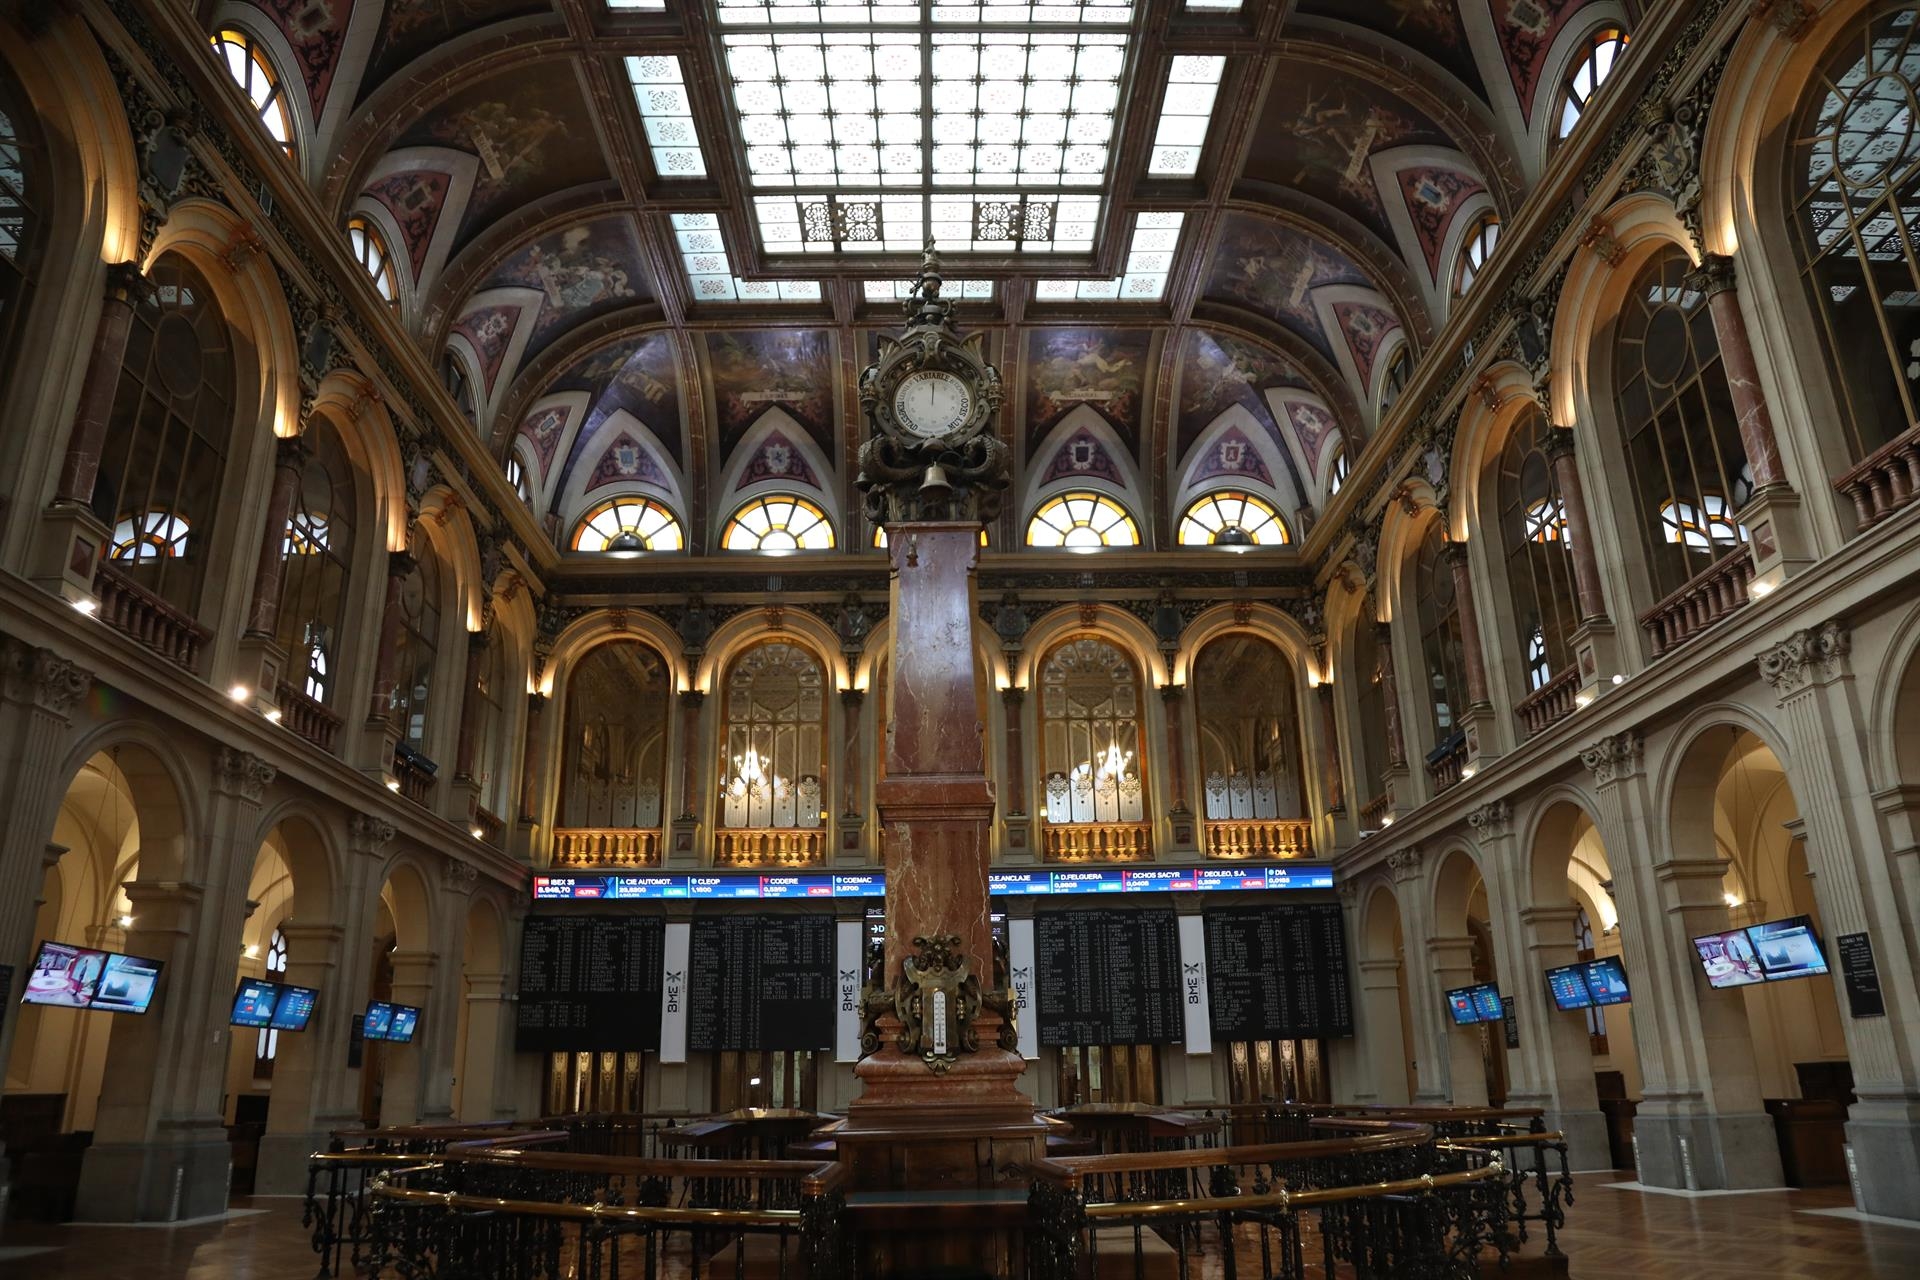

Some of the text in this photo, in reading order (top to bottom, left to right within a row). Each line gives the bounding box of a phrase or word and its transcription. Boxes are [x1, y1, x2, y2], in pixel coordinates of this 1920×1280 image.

[913, 372, 951, 383] VARIABLE
[897, 401, 918, 431] TEMPESTAD
[947, 398, 969, 431] MUY SECO
[1060, 873, 1103, 881] D.FELGUERA
[667, 985, 678, 1013] BME
[842, 984, 853, 1012] BME
[1015, 981, 1027, 1009] BME
[1187, 977, 1199, 1005] BME
